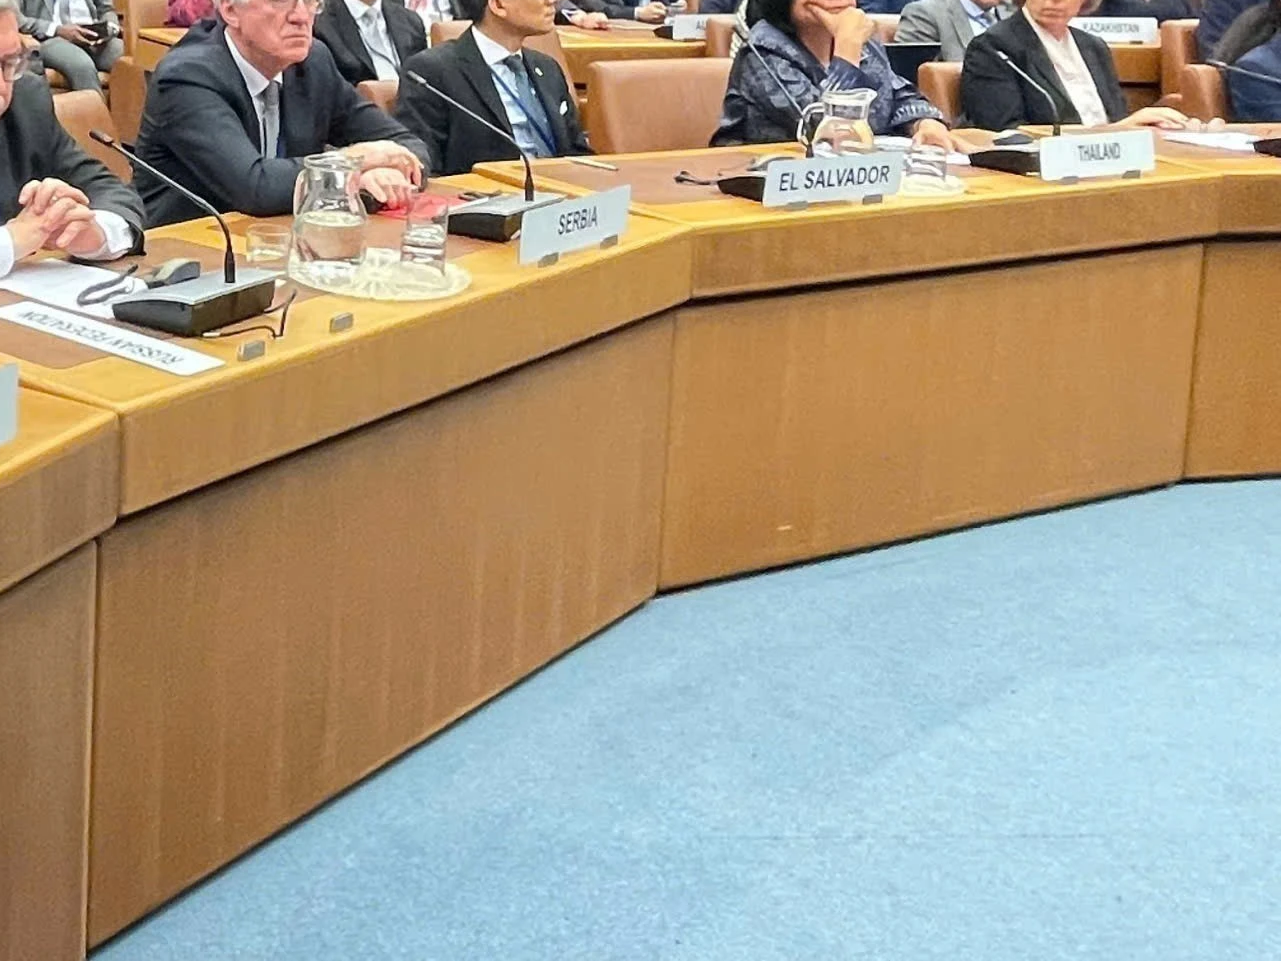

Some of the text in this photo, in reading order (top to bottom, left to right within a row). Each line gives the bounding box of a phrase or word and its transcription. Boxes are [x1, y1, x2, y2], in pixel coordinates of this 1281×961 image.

[1082, 22, 1140, 33] KAZAKHSTAN
[1077, 142, 1121, 160] THAILAND
[778, 165, 890, 192] EL SALVADOR
[557, 205, 598, 236] SERBIA
